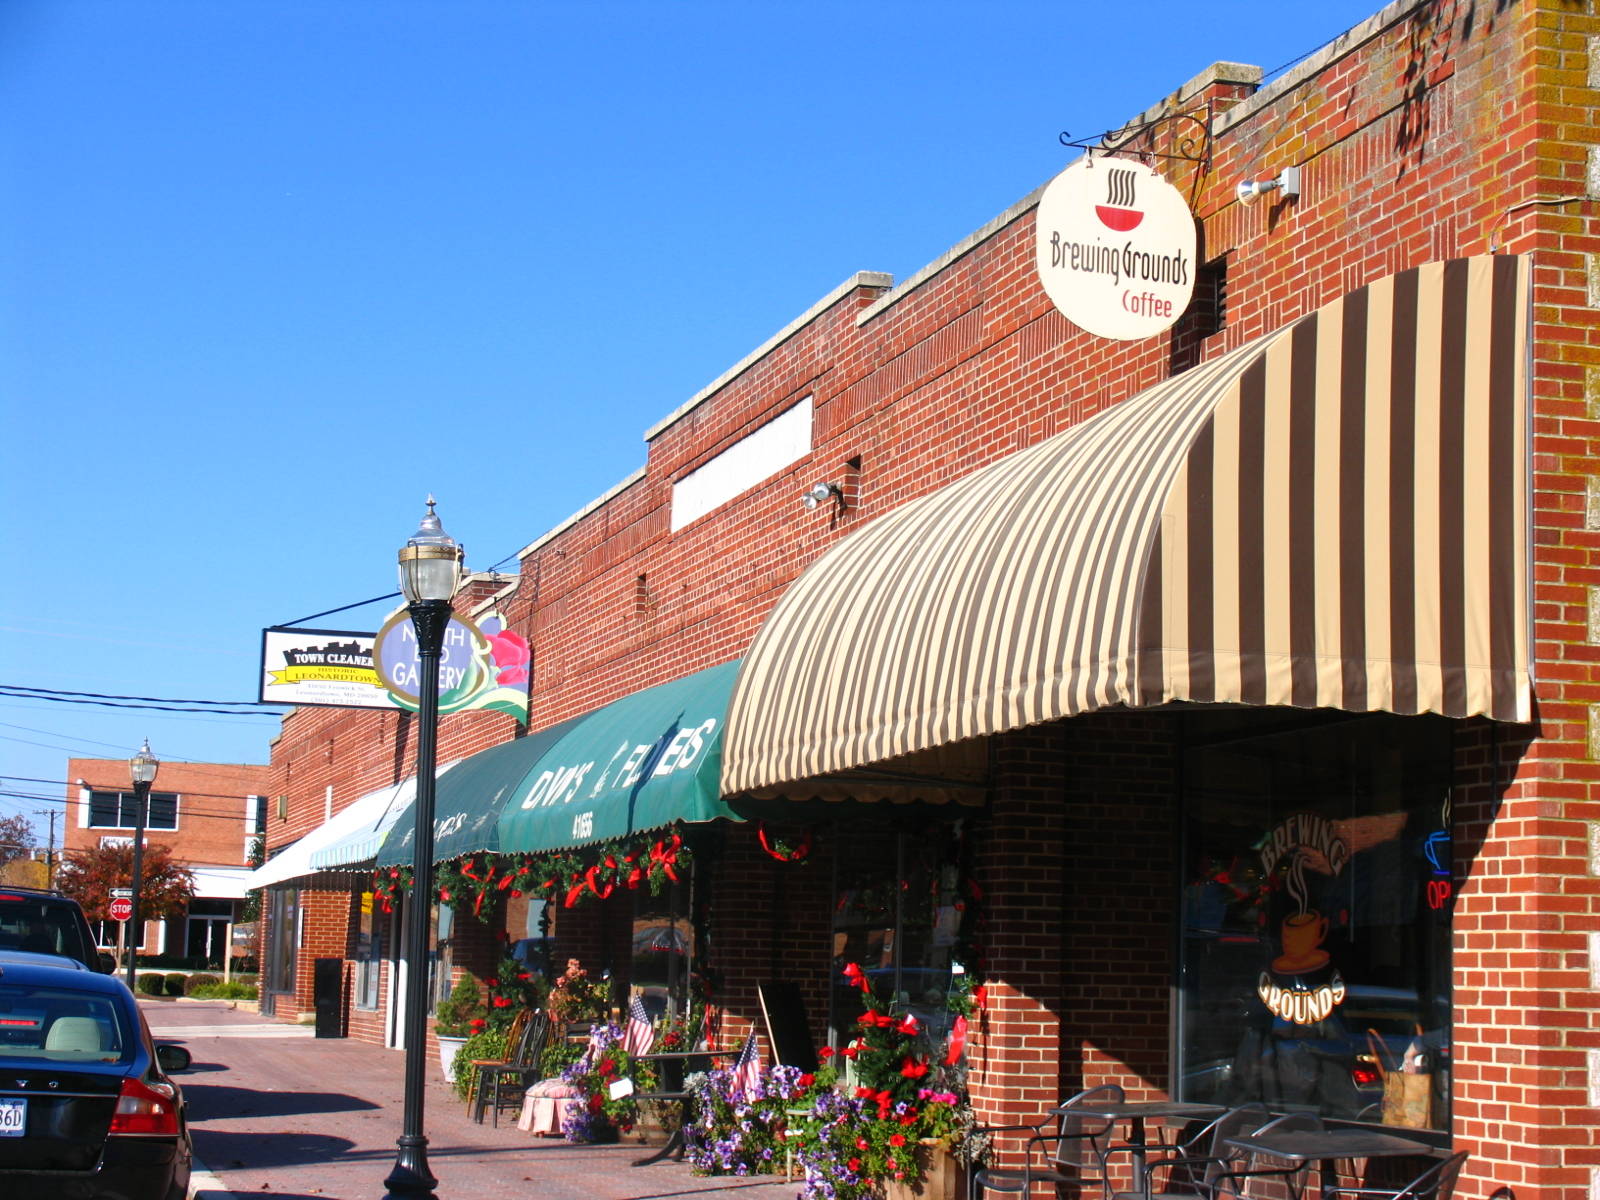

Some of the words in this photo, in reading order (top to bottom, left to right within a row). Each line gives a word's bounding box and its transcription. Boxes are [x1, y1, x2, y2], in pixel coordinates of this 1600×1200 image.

[1122, 289, 1172, 318] Coffee
[402, 623, 465, 646] NTH
[294, 653, 325, 664] TOWN
[414, 644, 450, 664] ED
[392, 662, 466, 690] GAERY
[1260, 814, 1345, 876] BREWING
[1427, 880, 1451, 909] OP
[112, 904, 132, 914] STOP
[1257, 969, 1346, 1025] GROUNDS
